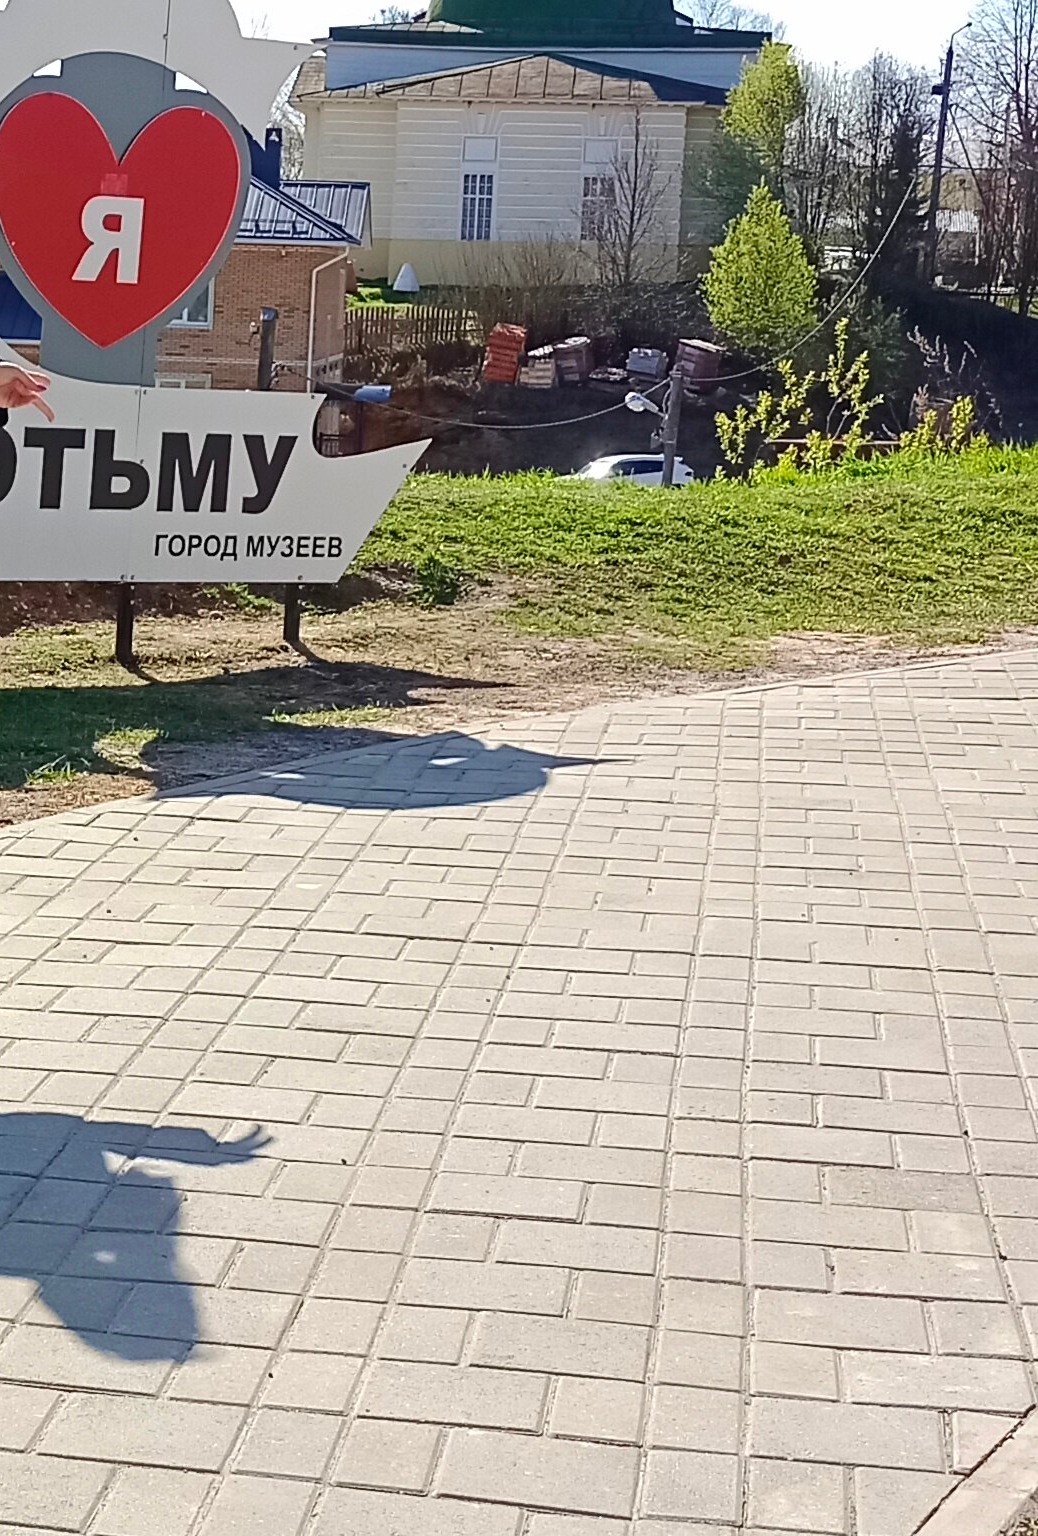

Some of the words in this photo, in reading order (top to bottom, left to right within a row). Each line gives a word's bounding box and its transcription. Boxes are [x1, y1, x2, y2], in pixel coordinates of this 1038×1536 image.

[71, 195, 145, 285] Я
[153, 533, 238, 561] ГОРОД
[245, 534, 343, 558] МУЗЕЕВ
